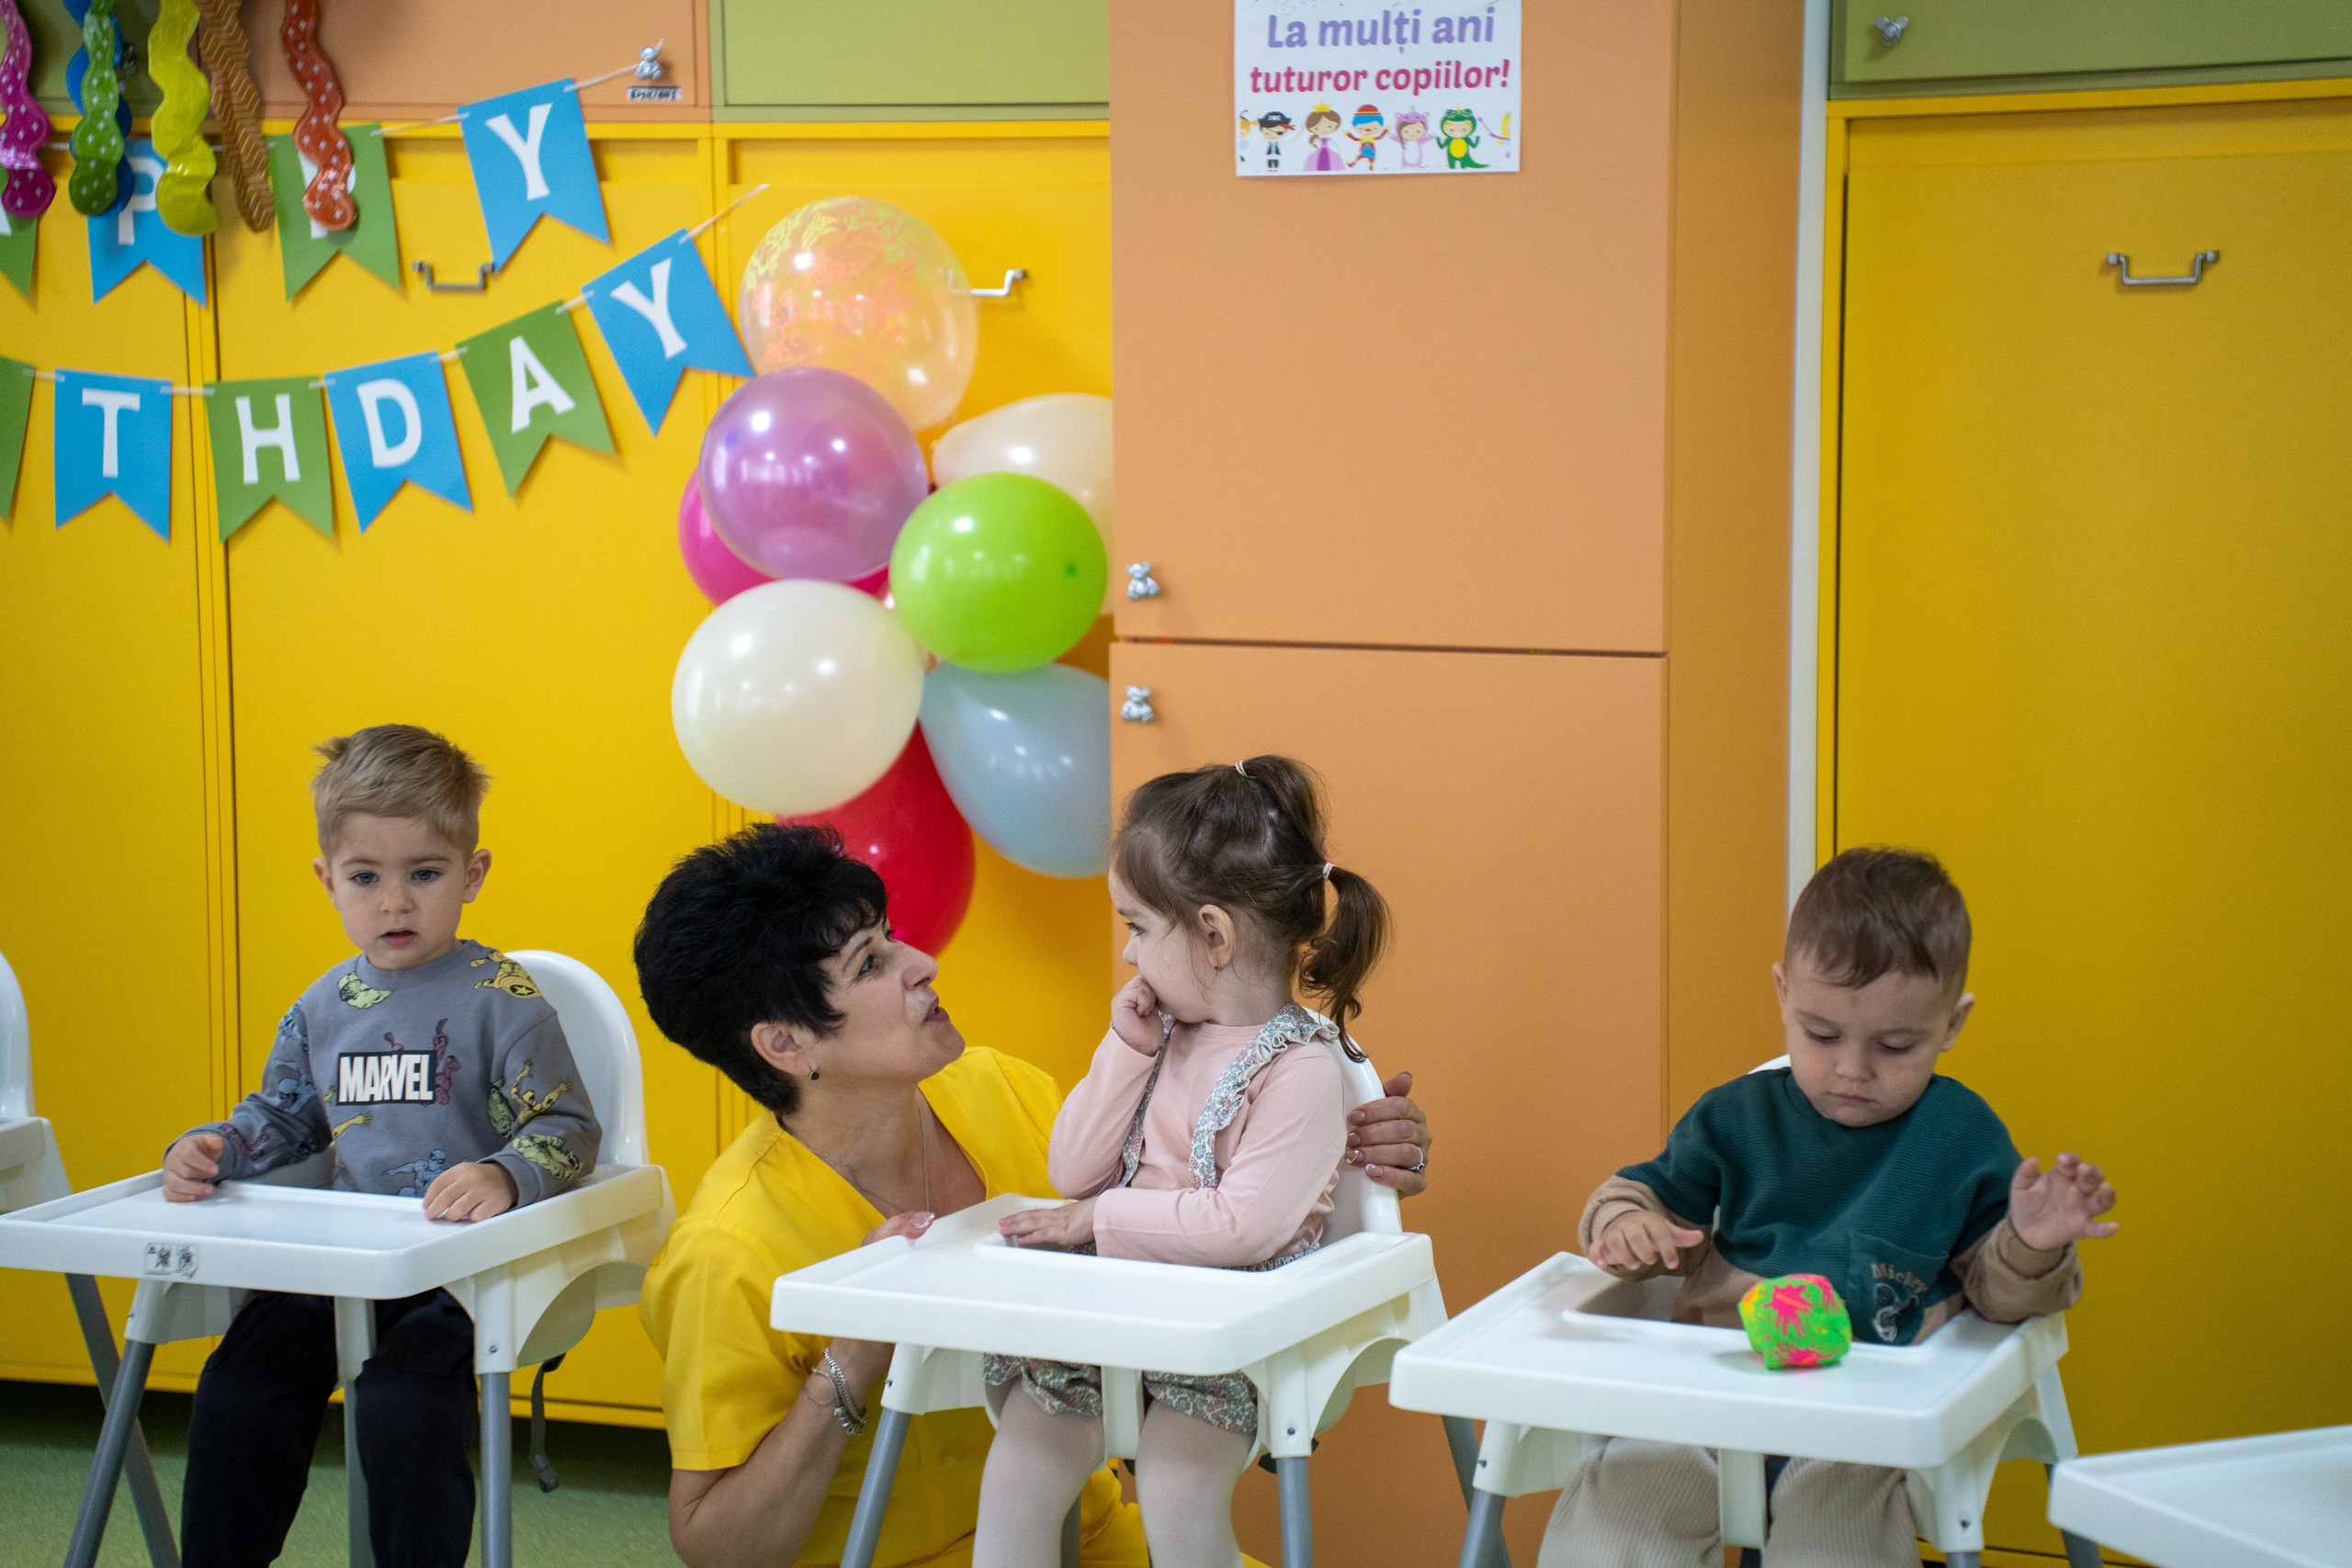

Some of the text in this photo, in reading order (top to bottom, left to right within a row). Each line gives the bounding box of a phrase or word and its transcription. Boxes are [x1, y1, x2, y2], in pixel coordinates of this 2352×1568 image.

[1267, 6, 1496, 54] La mulți ani
[1250, 58, 1511, 96] tuturor copiilor!
[338, 1054, 434, 1103] MARVEL
